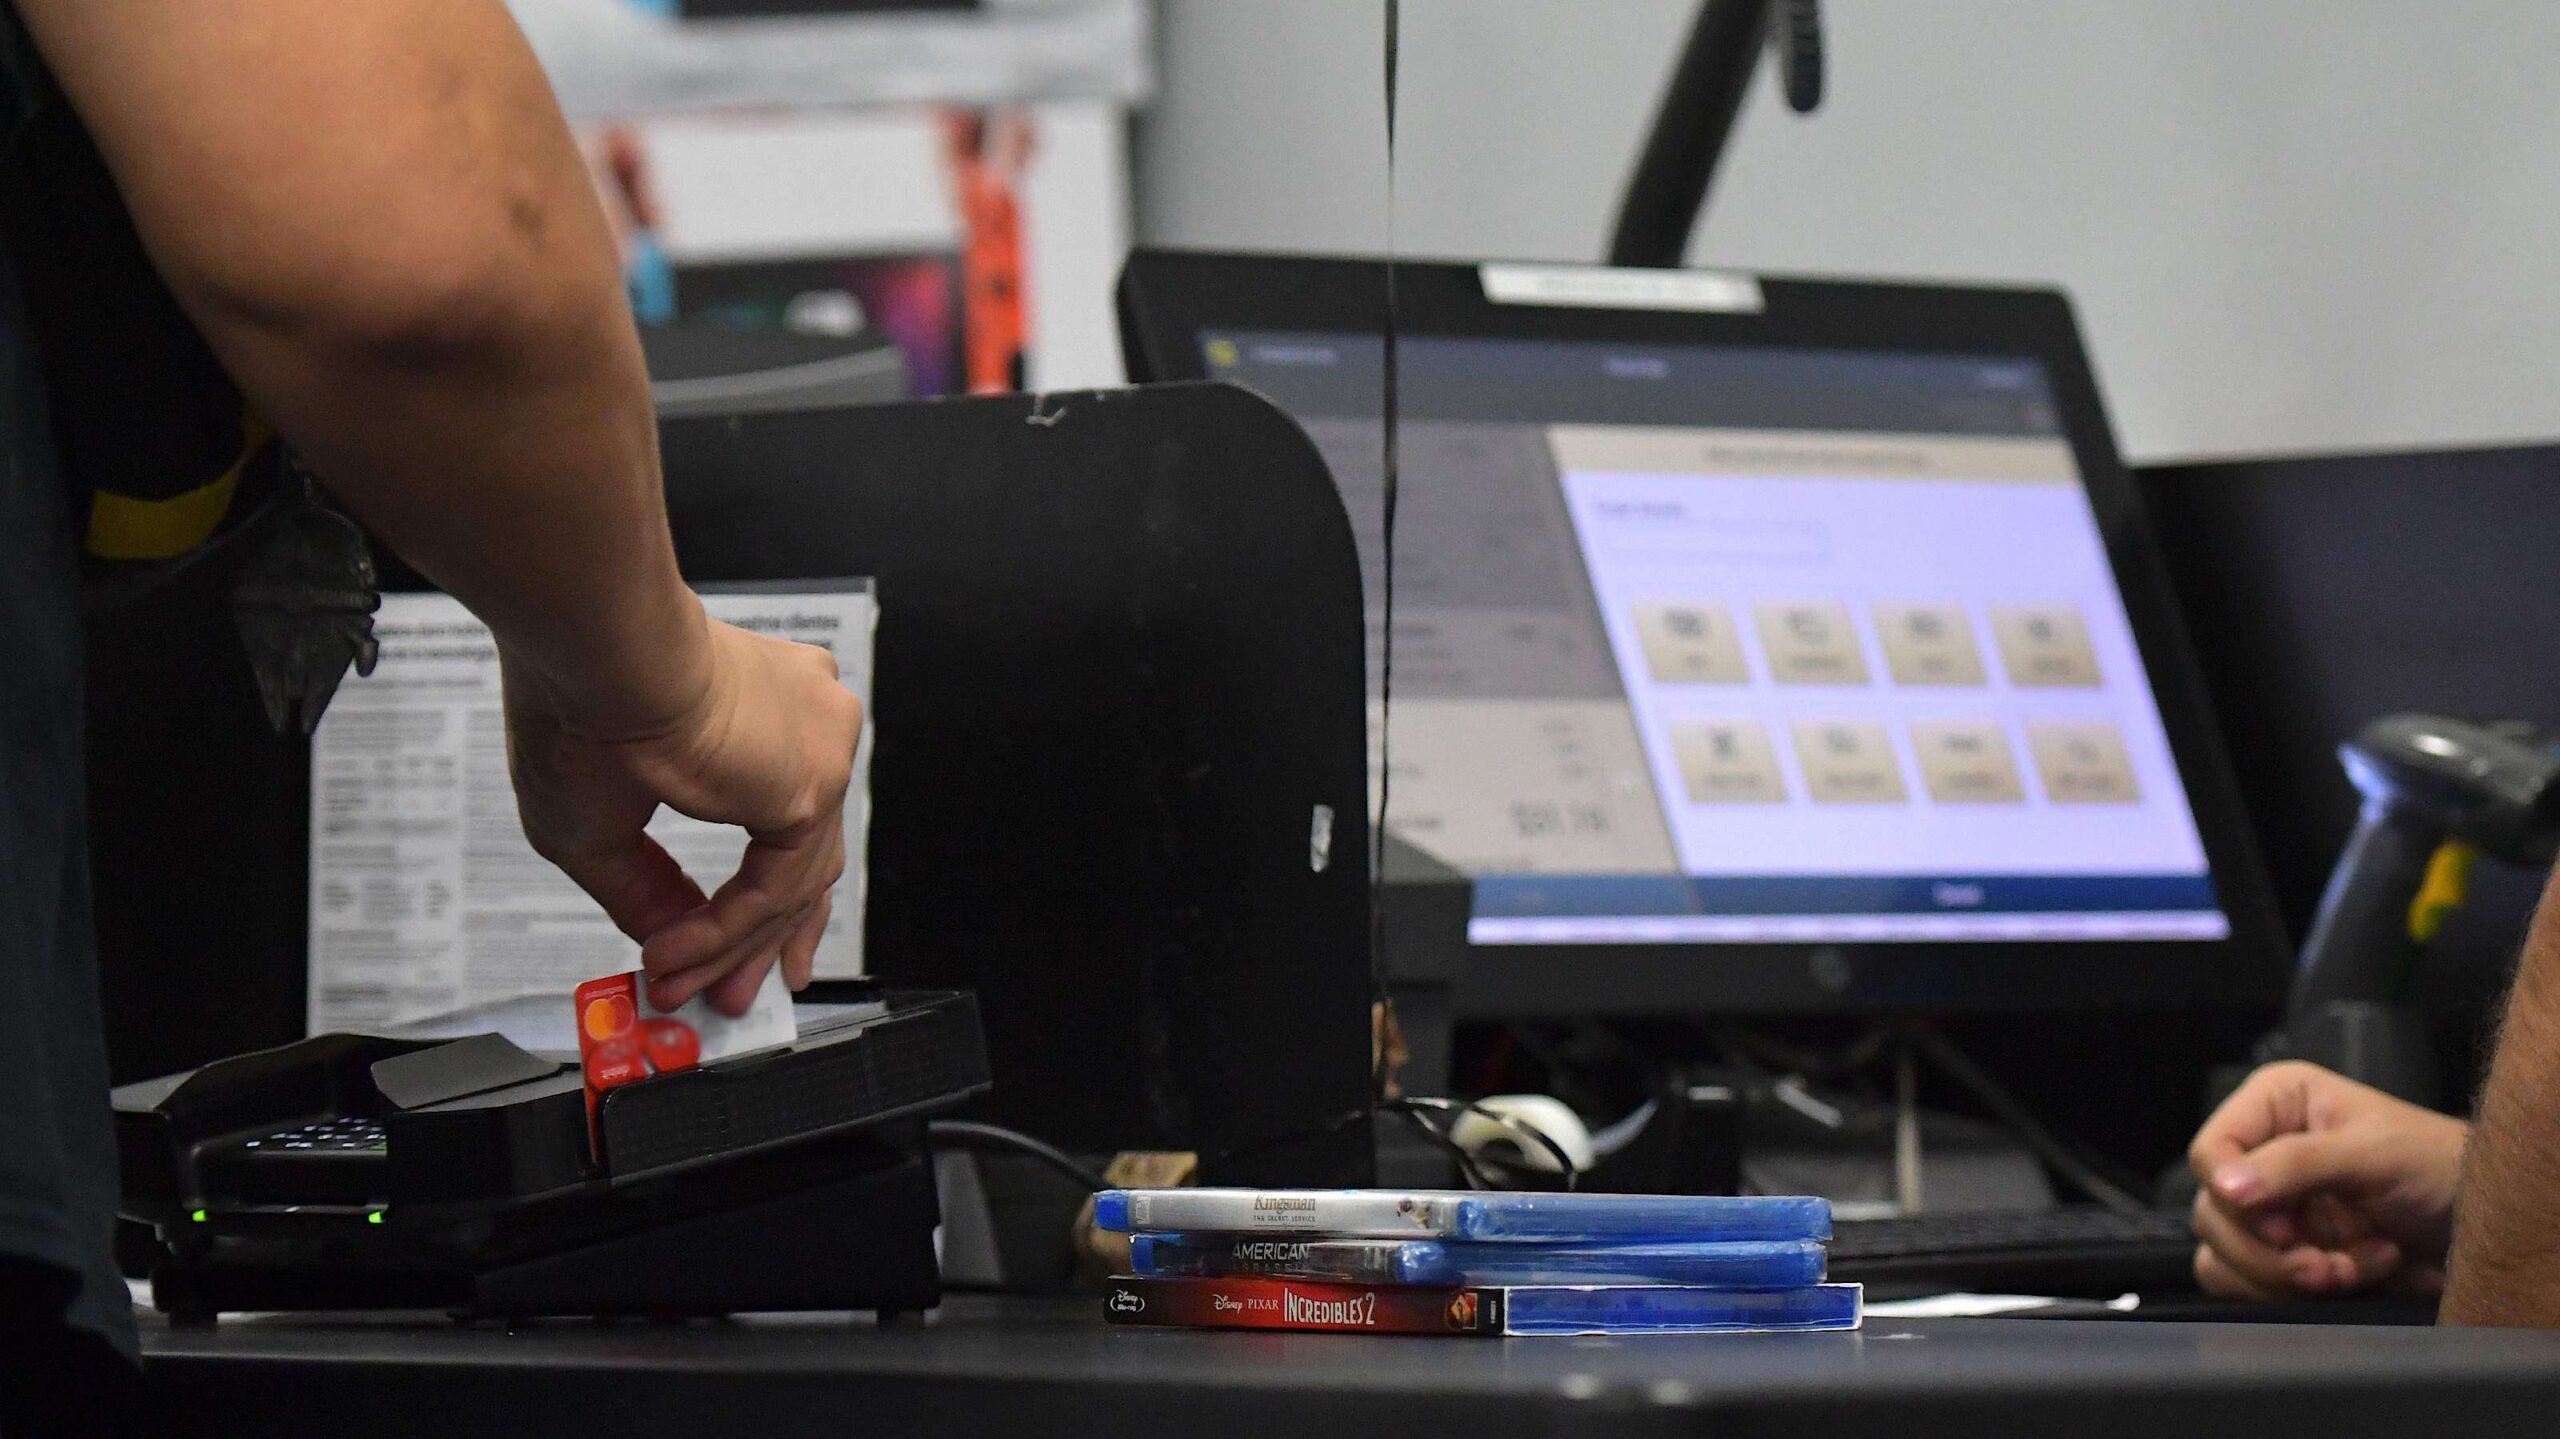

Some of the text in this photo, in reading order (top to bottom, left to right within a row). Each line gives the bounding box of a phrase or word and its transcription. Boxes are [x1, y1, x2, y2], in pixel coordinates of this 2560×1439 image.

[1253, 1194, 1316, 1214] Kingsman
[1232, 1242, 1310, 1260] AMERICAN
[1212, 1288, 1375, 1325] Disney PIXAR INCREDIBLES 2
